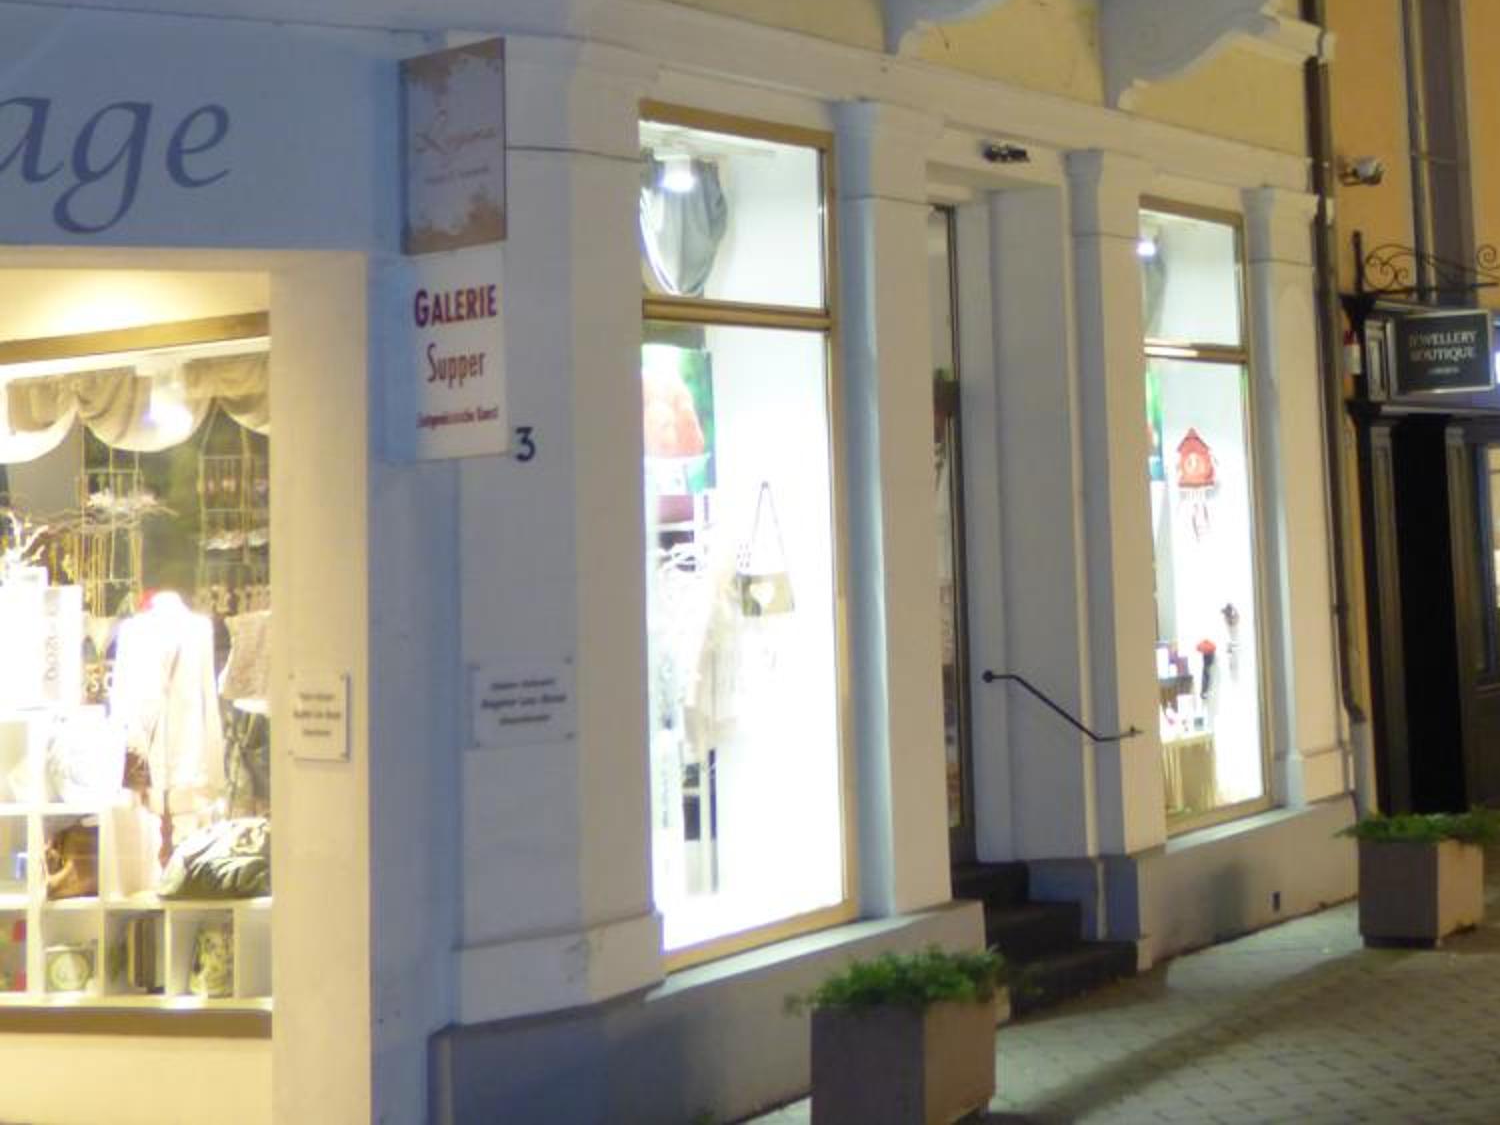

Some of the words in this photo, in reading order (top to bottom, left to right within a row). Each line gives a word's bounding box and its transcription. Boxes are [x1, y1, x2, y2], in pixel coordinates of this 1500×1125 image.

[414, 284, 497, 327] GALERIE
[427, 341, 486, 389] Supper
[515, 426, 536, 462] 3
